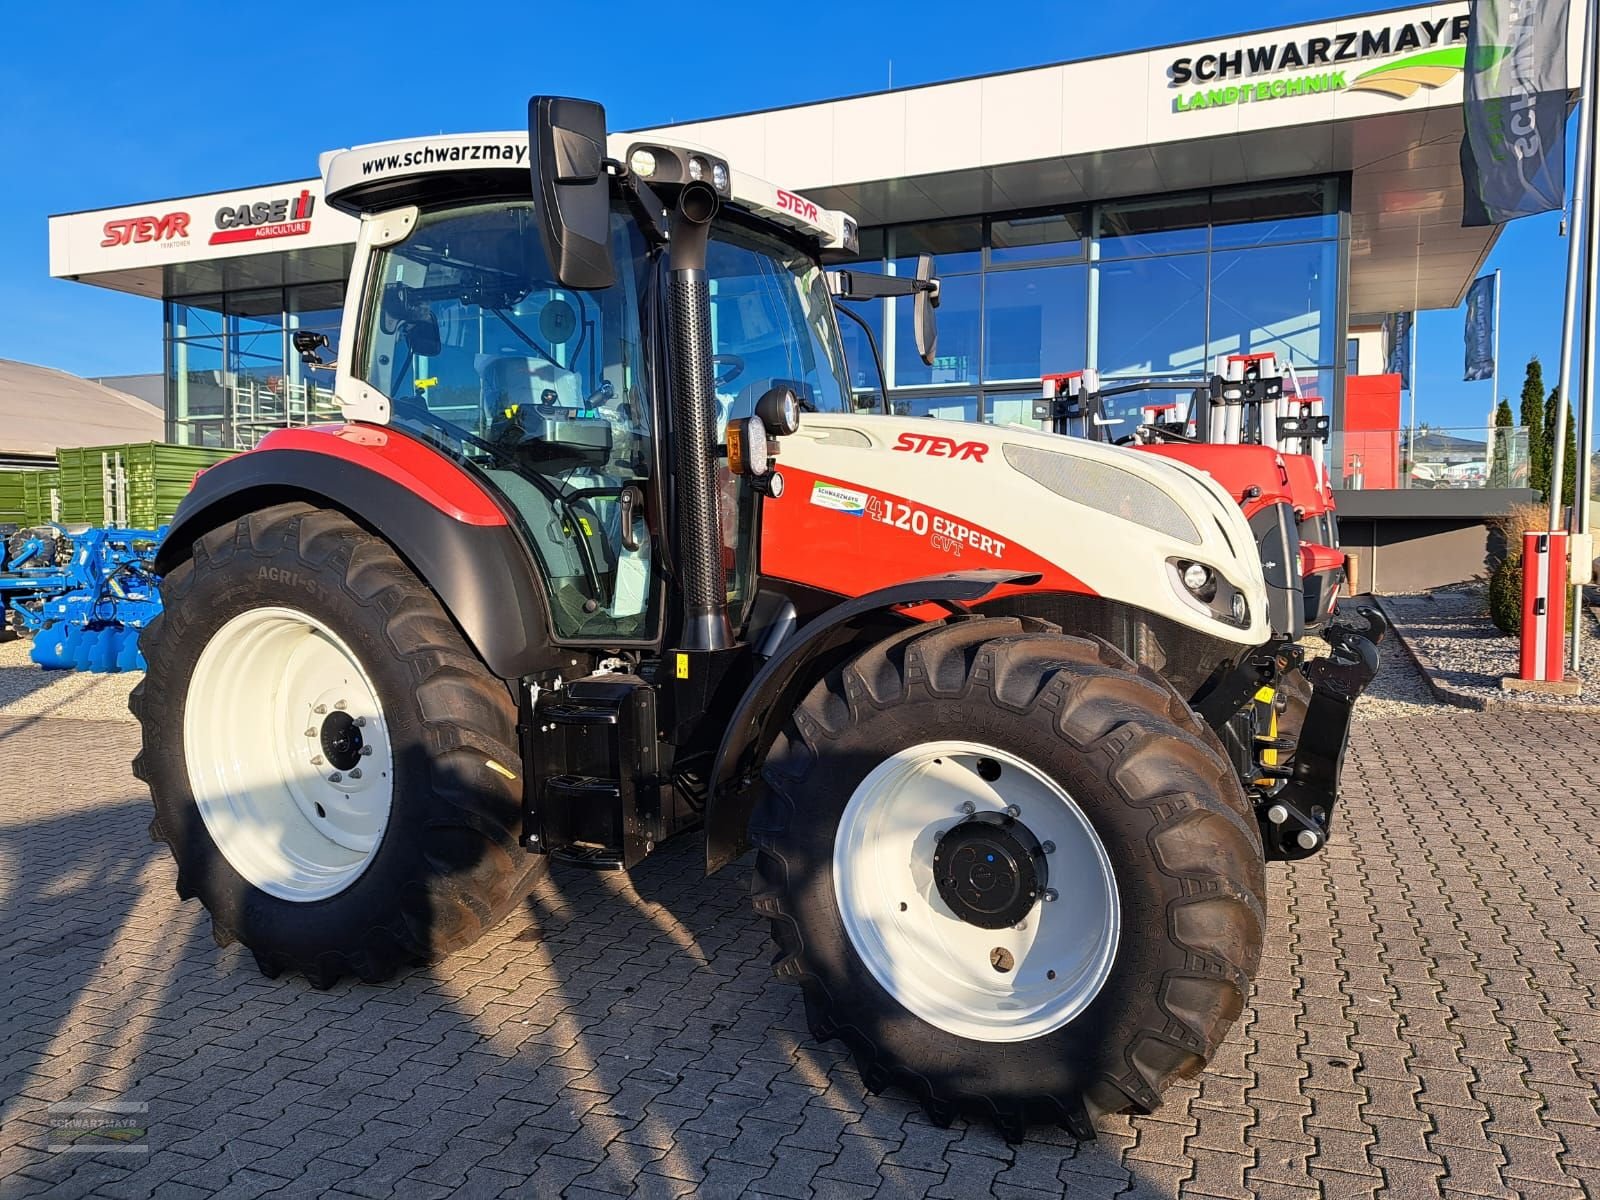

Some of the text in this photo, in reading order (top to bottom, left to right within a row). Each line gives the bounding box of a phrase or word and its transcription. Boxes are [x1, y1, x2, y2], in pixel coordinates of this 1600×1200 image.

[1172, 15, 1470, 84] SCHWARZMAYR
[1176, 71, 1347, 112] LANDTECHNIK
[362, 145, 528, 175] www.schwarzmay
[214, 199, 288, 229] CASE
[776, 189, 818, 223] STEYR
[100, 212, 191, 248] STEYR
[255, 222, 306, 237] AGRICULTURE
[892, 432, 989, 463] STEYR
[865, 496, 1006, 558] 4120 EXPERT
[931, 533, 963, 557] CVT
